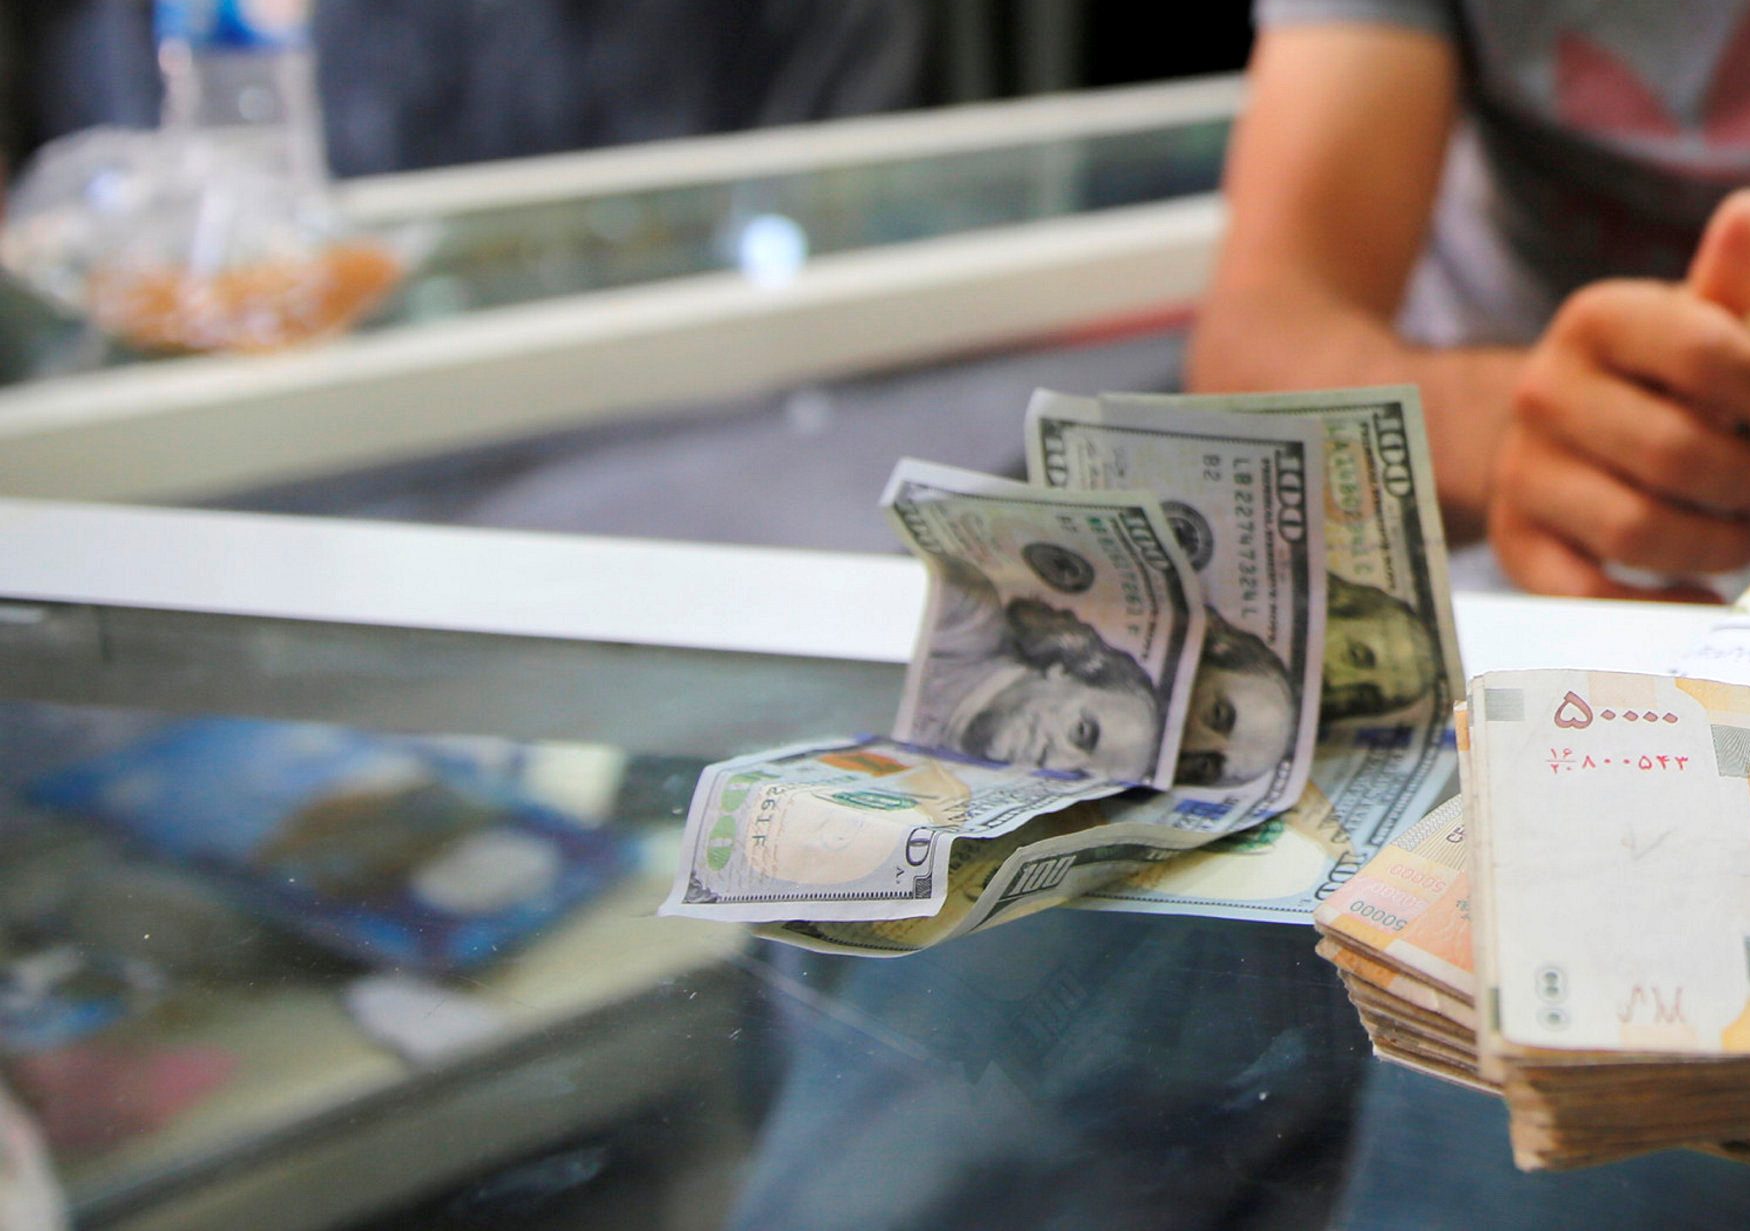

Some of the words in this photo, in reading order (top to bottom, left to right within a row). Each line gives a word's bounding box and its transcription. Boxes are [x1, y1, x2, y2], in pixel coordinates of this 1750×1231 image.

[1374, 414, 1412, 498] 100
[1275, 451, 1305, 544] 100
[1553, 689, 1680, 730] ۵۰۰۰۰
[1009, 855, 1077, 897] 100
[1350, 900, 1408, 932] 50000
